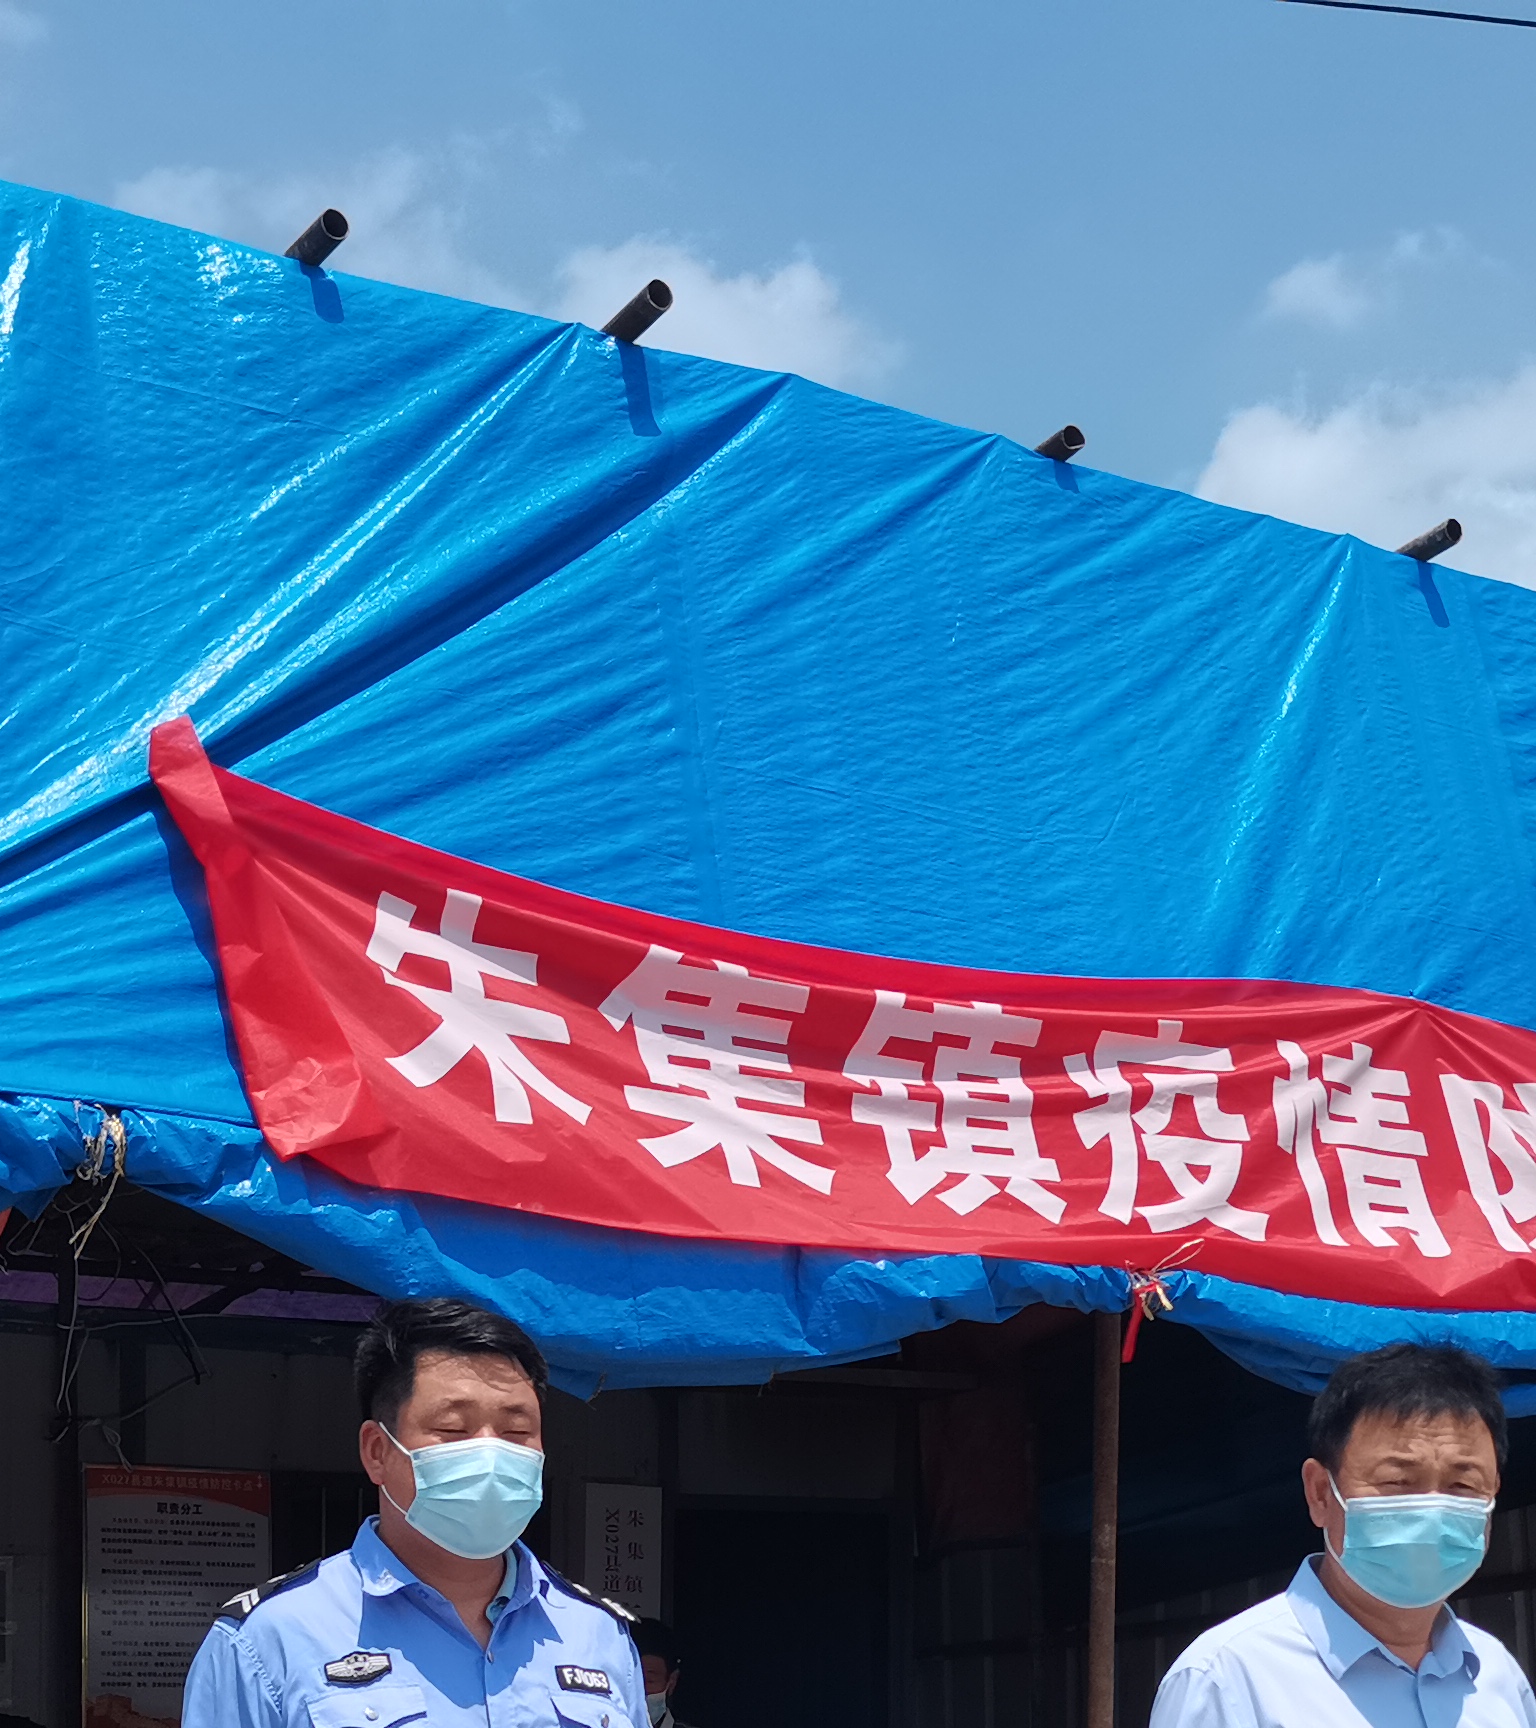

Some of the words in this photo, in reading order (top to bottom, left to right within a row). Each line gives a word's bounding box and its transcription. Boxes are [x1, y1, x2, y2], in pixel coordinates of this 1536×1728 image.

[156, 1502, 203, 1515] 职责分工
[624, 1509, 645, 1609] 朱集镇
